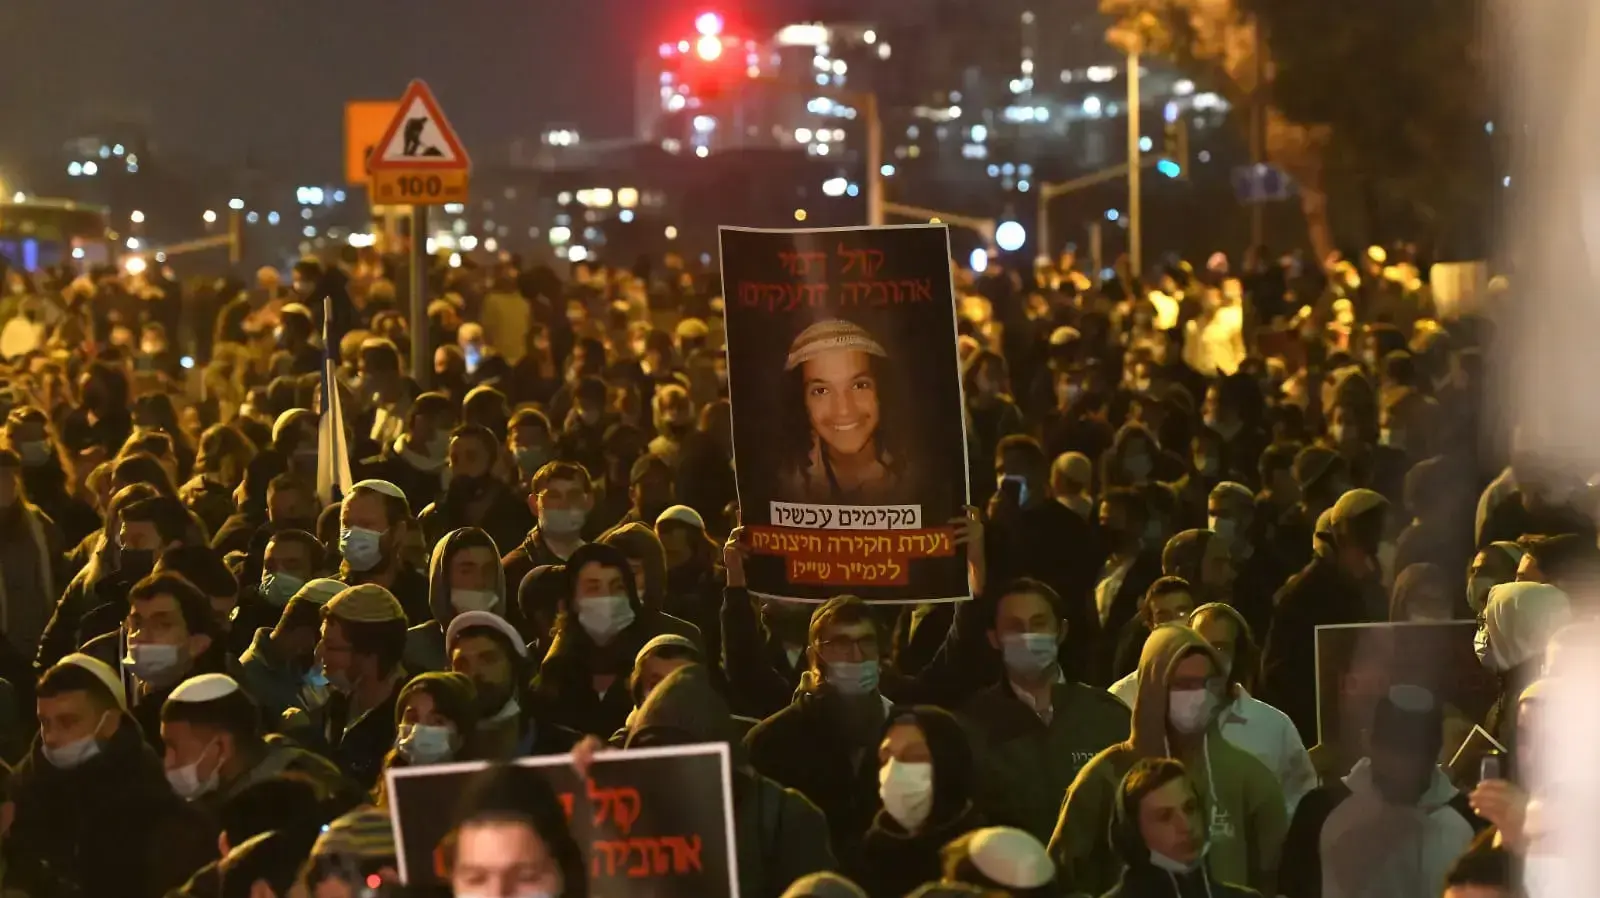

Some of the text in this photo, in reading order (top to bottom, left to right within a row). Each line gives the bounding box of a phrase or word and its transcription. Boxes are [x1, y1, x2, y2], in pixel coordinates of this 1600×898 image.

[397, 175, 442, 197] 100
[778, 241, 884, 278] קול דמי
[840, 279, 933, 306] אהוביה
[775, 507, 916, 530] מקימים עכשיו
[752, 531, 949, 557] ועדת חקירה חיצונית
[592, 833, 702, 879] אהוביה
